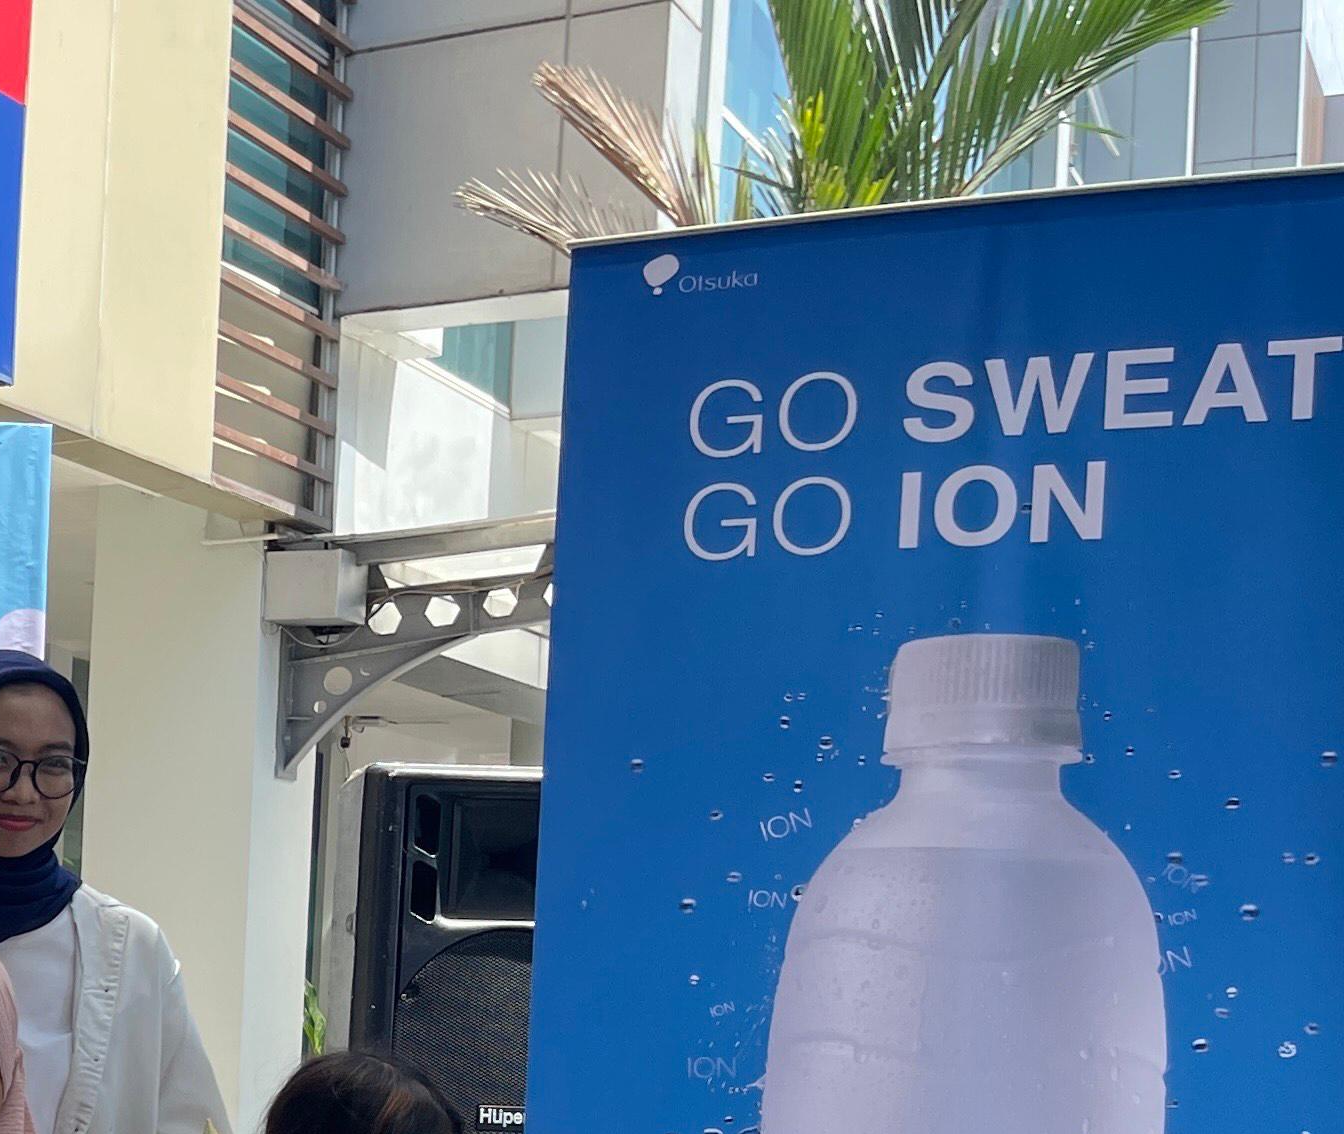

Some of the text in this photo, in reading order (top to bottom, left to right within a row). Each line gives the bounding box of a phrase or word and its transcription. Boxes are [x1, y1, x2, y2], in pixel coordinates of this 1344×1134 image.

[689, 336, 1344, 458] GO SWEAT
[683, 460, 1106, 561] GO ION
[760, 808, 812, 841] ION
[747, 889, 787, 910] ION
[1167, 908, 1198, 926] ION
[709, 1001, 736, 1018] ION
[687, 1056, 737, 1079] ION
